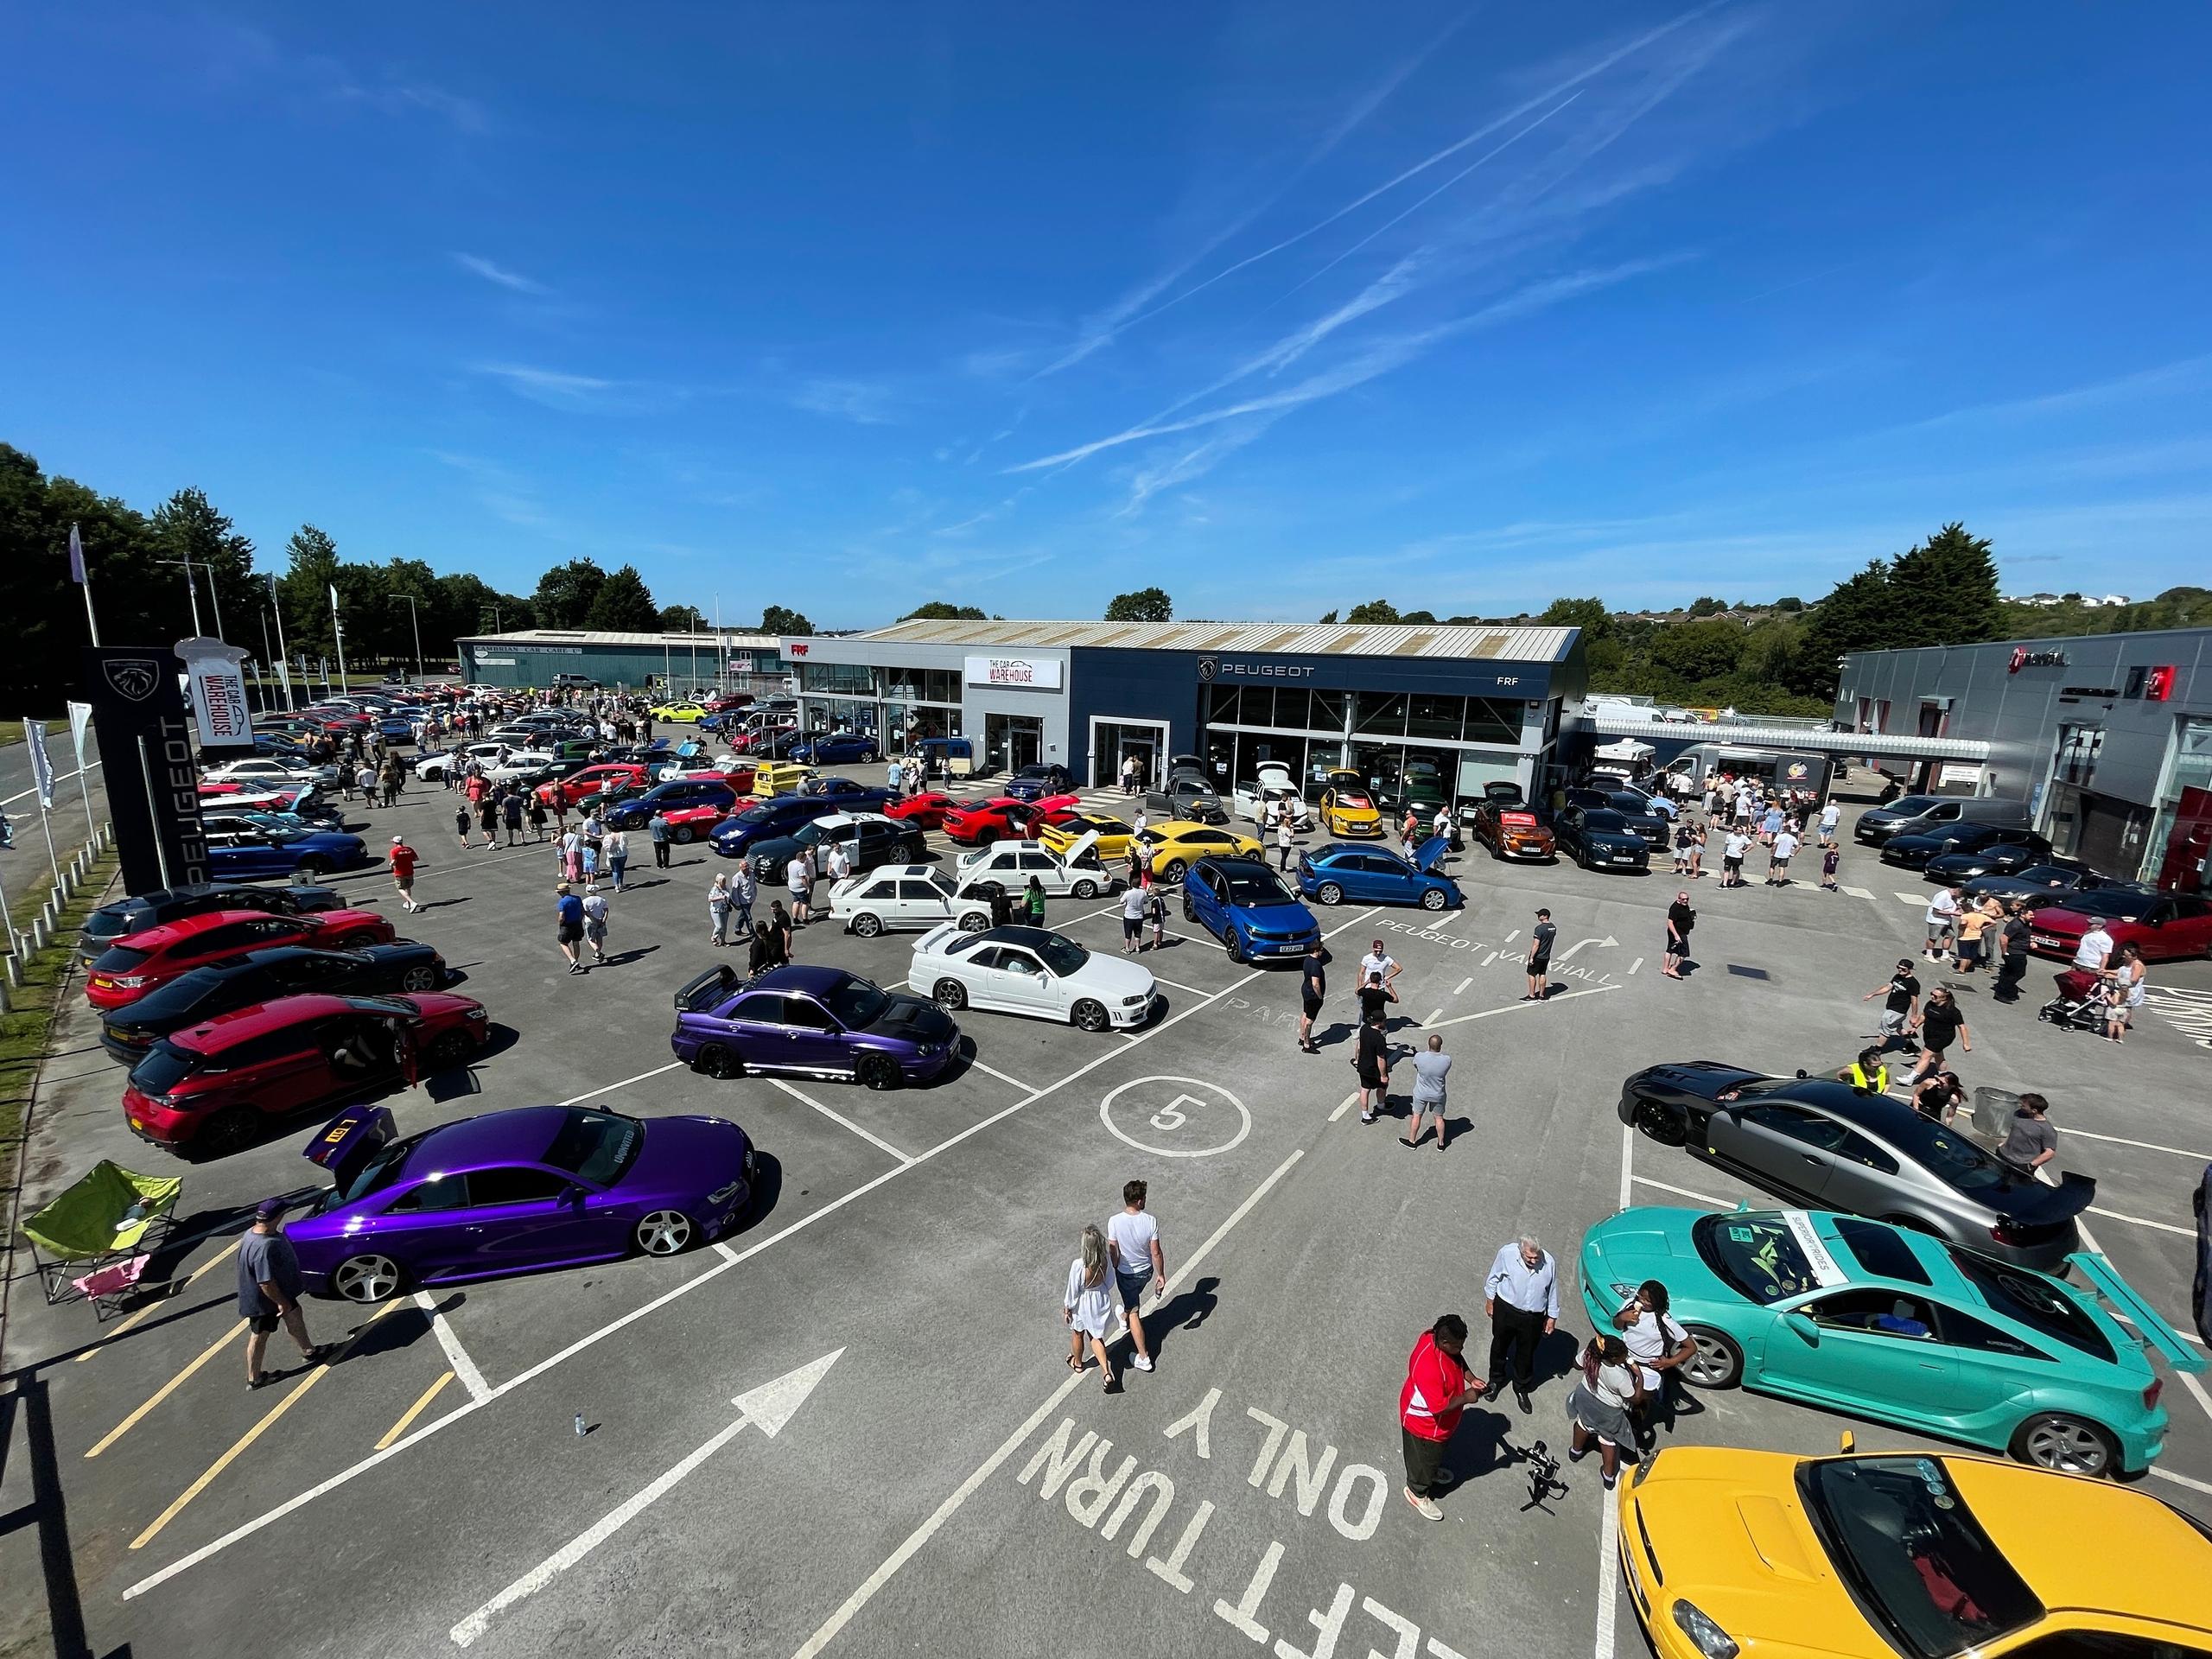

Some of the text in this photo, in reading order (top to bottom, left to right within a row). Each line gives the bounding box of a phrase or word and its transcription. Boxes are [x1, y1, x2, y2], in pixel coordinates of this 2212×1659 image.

[791, 644, 809, 657] FRF
[989, 659, 1010, 669] THE CAR
[989, 668, 1033, 682] WAREHOUSE
[1222, 664, 1315, 677] PEUGEOT
[1497, 677, 1519, 685] FRF
[205, 675, 232, 736] WAREHOUSE
[224, 675, 241, 704] THE CAR
[160, 715, 207, 886] PEUGEOT
[1375, 918, 1489, 952] PEUGEOT
[1498, 949, 1612, 987] VAXHALL
[1149, 1093, 1207, 1130] 5
[613, 1129, 635, 1164] UNINVITED
[1792, 1217, 1830, 1271] SUPERIOR RIDES
[1163, 1388, 1389, 1541] ONLY
[1016, 1417, 1467, 1658] FT TURN
